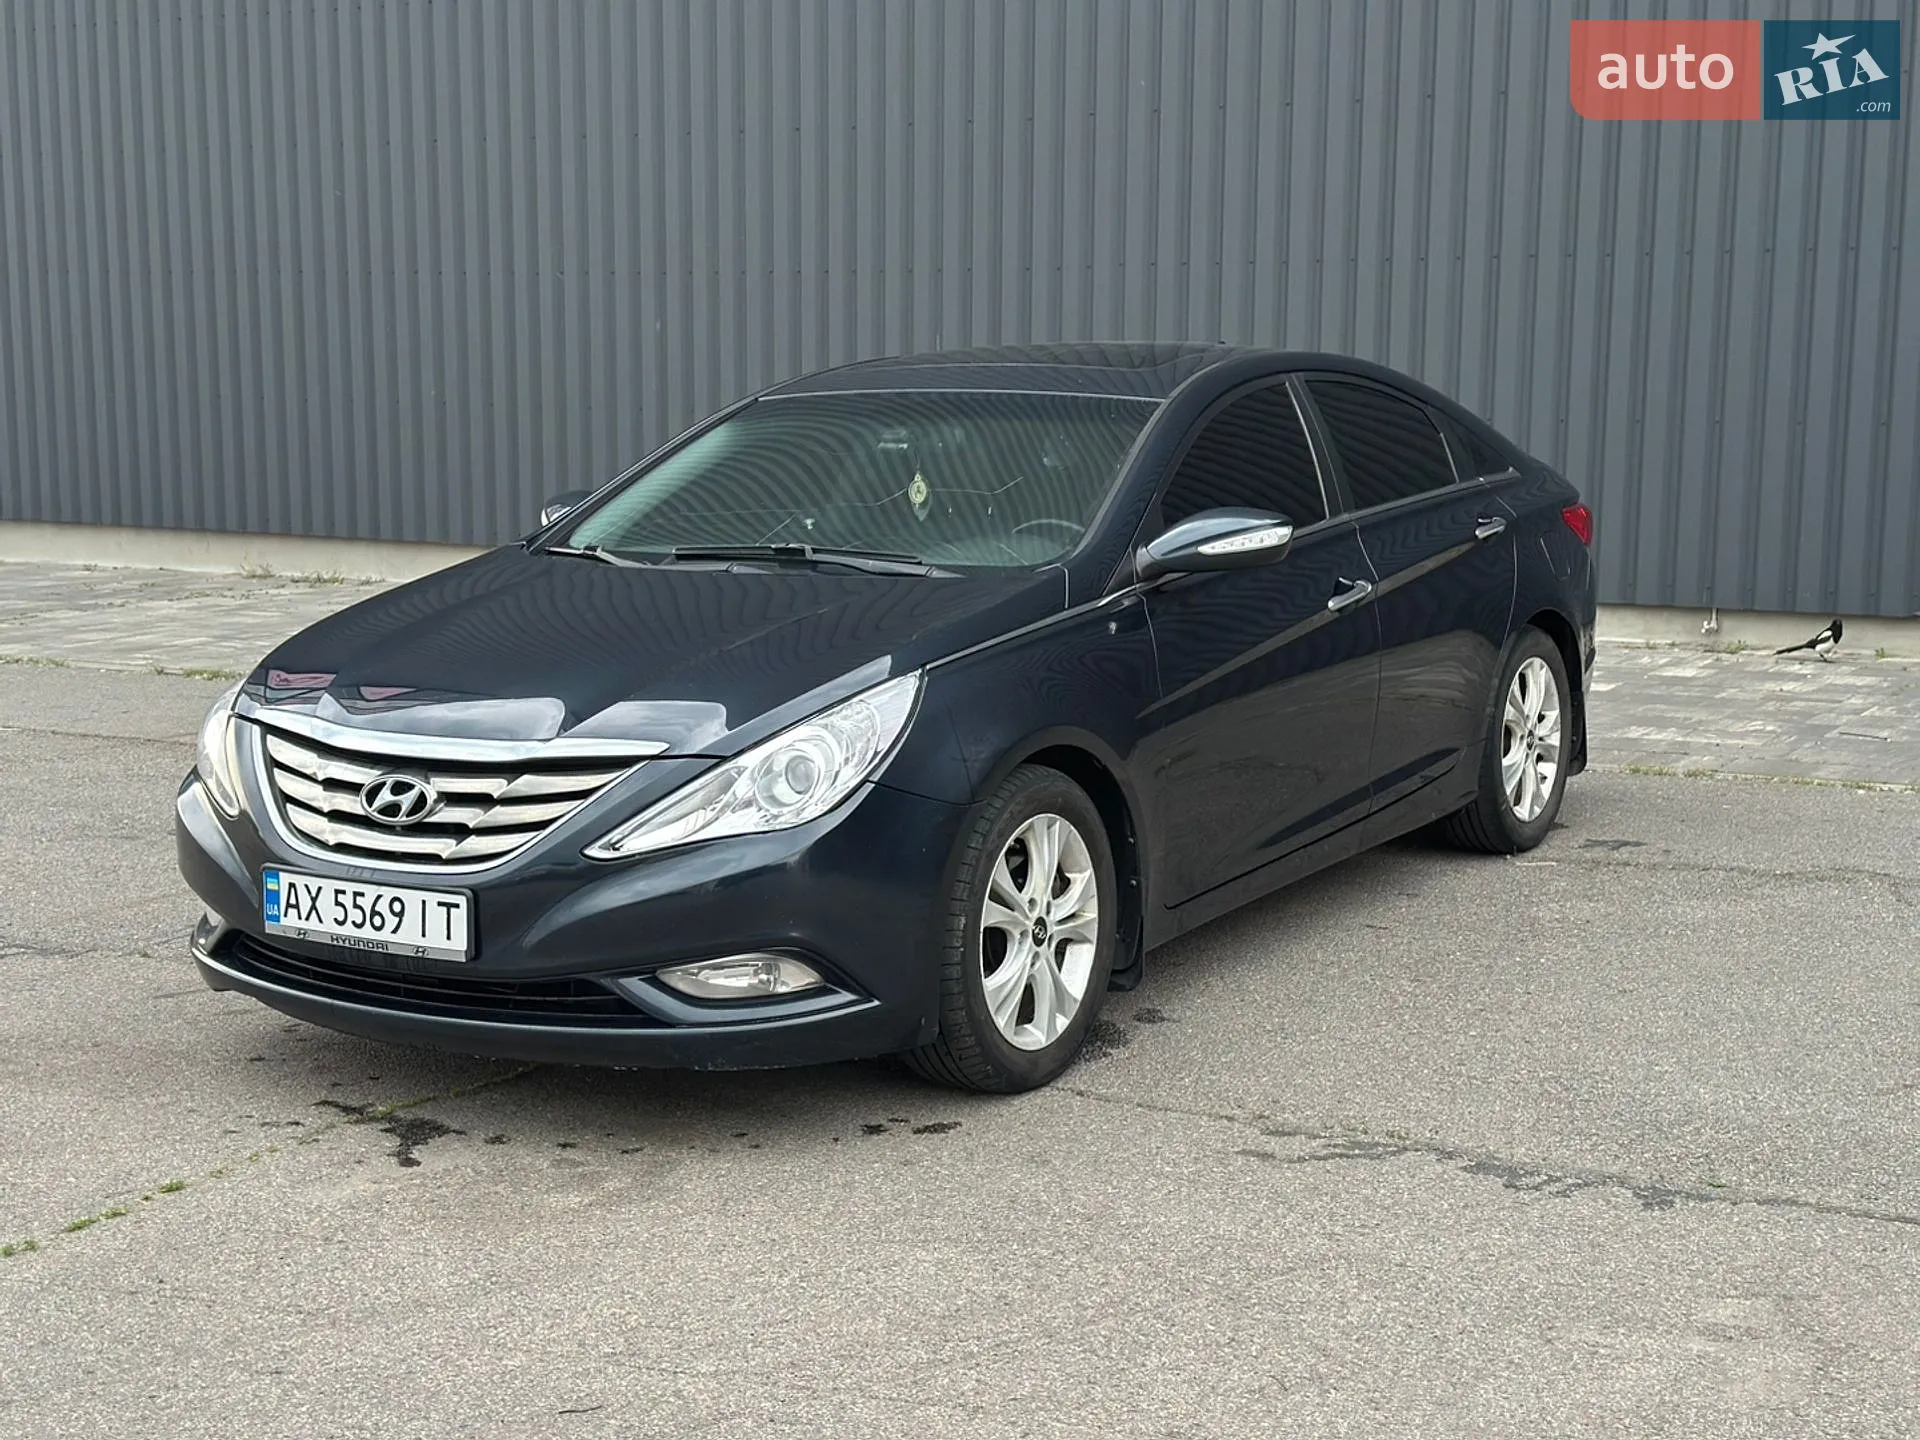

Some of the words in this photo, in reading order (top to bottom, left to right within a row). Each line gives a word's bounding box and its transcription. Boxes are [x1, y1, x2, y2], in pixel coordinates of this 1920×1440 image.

[266, 903, 279, 917] UA
[284, 882, 324, 924] AX
[333, 888, 406, 934] 5569
[421, 899, 460, 941] IT
[330, 935, 390, 952] HYUNDAI
